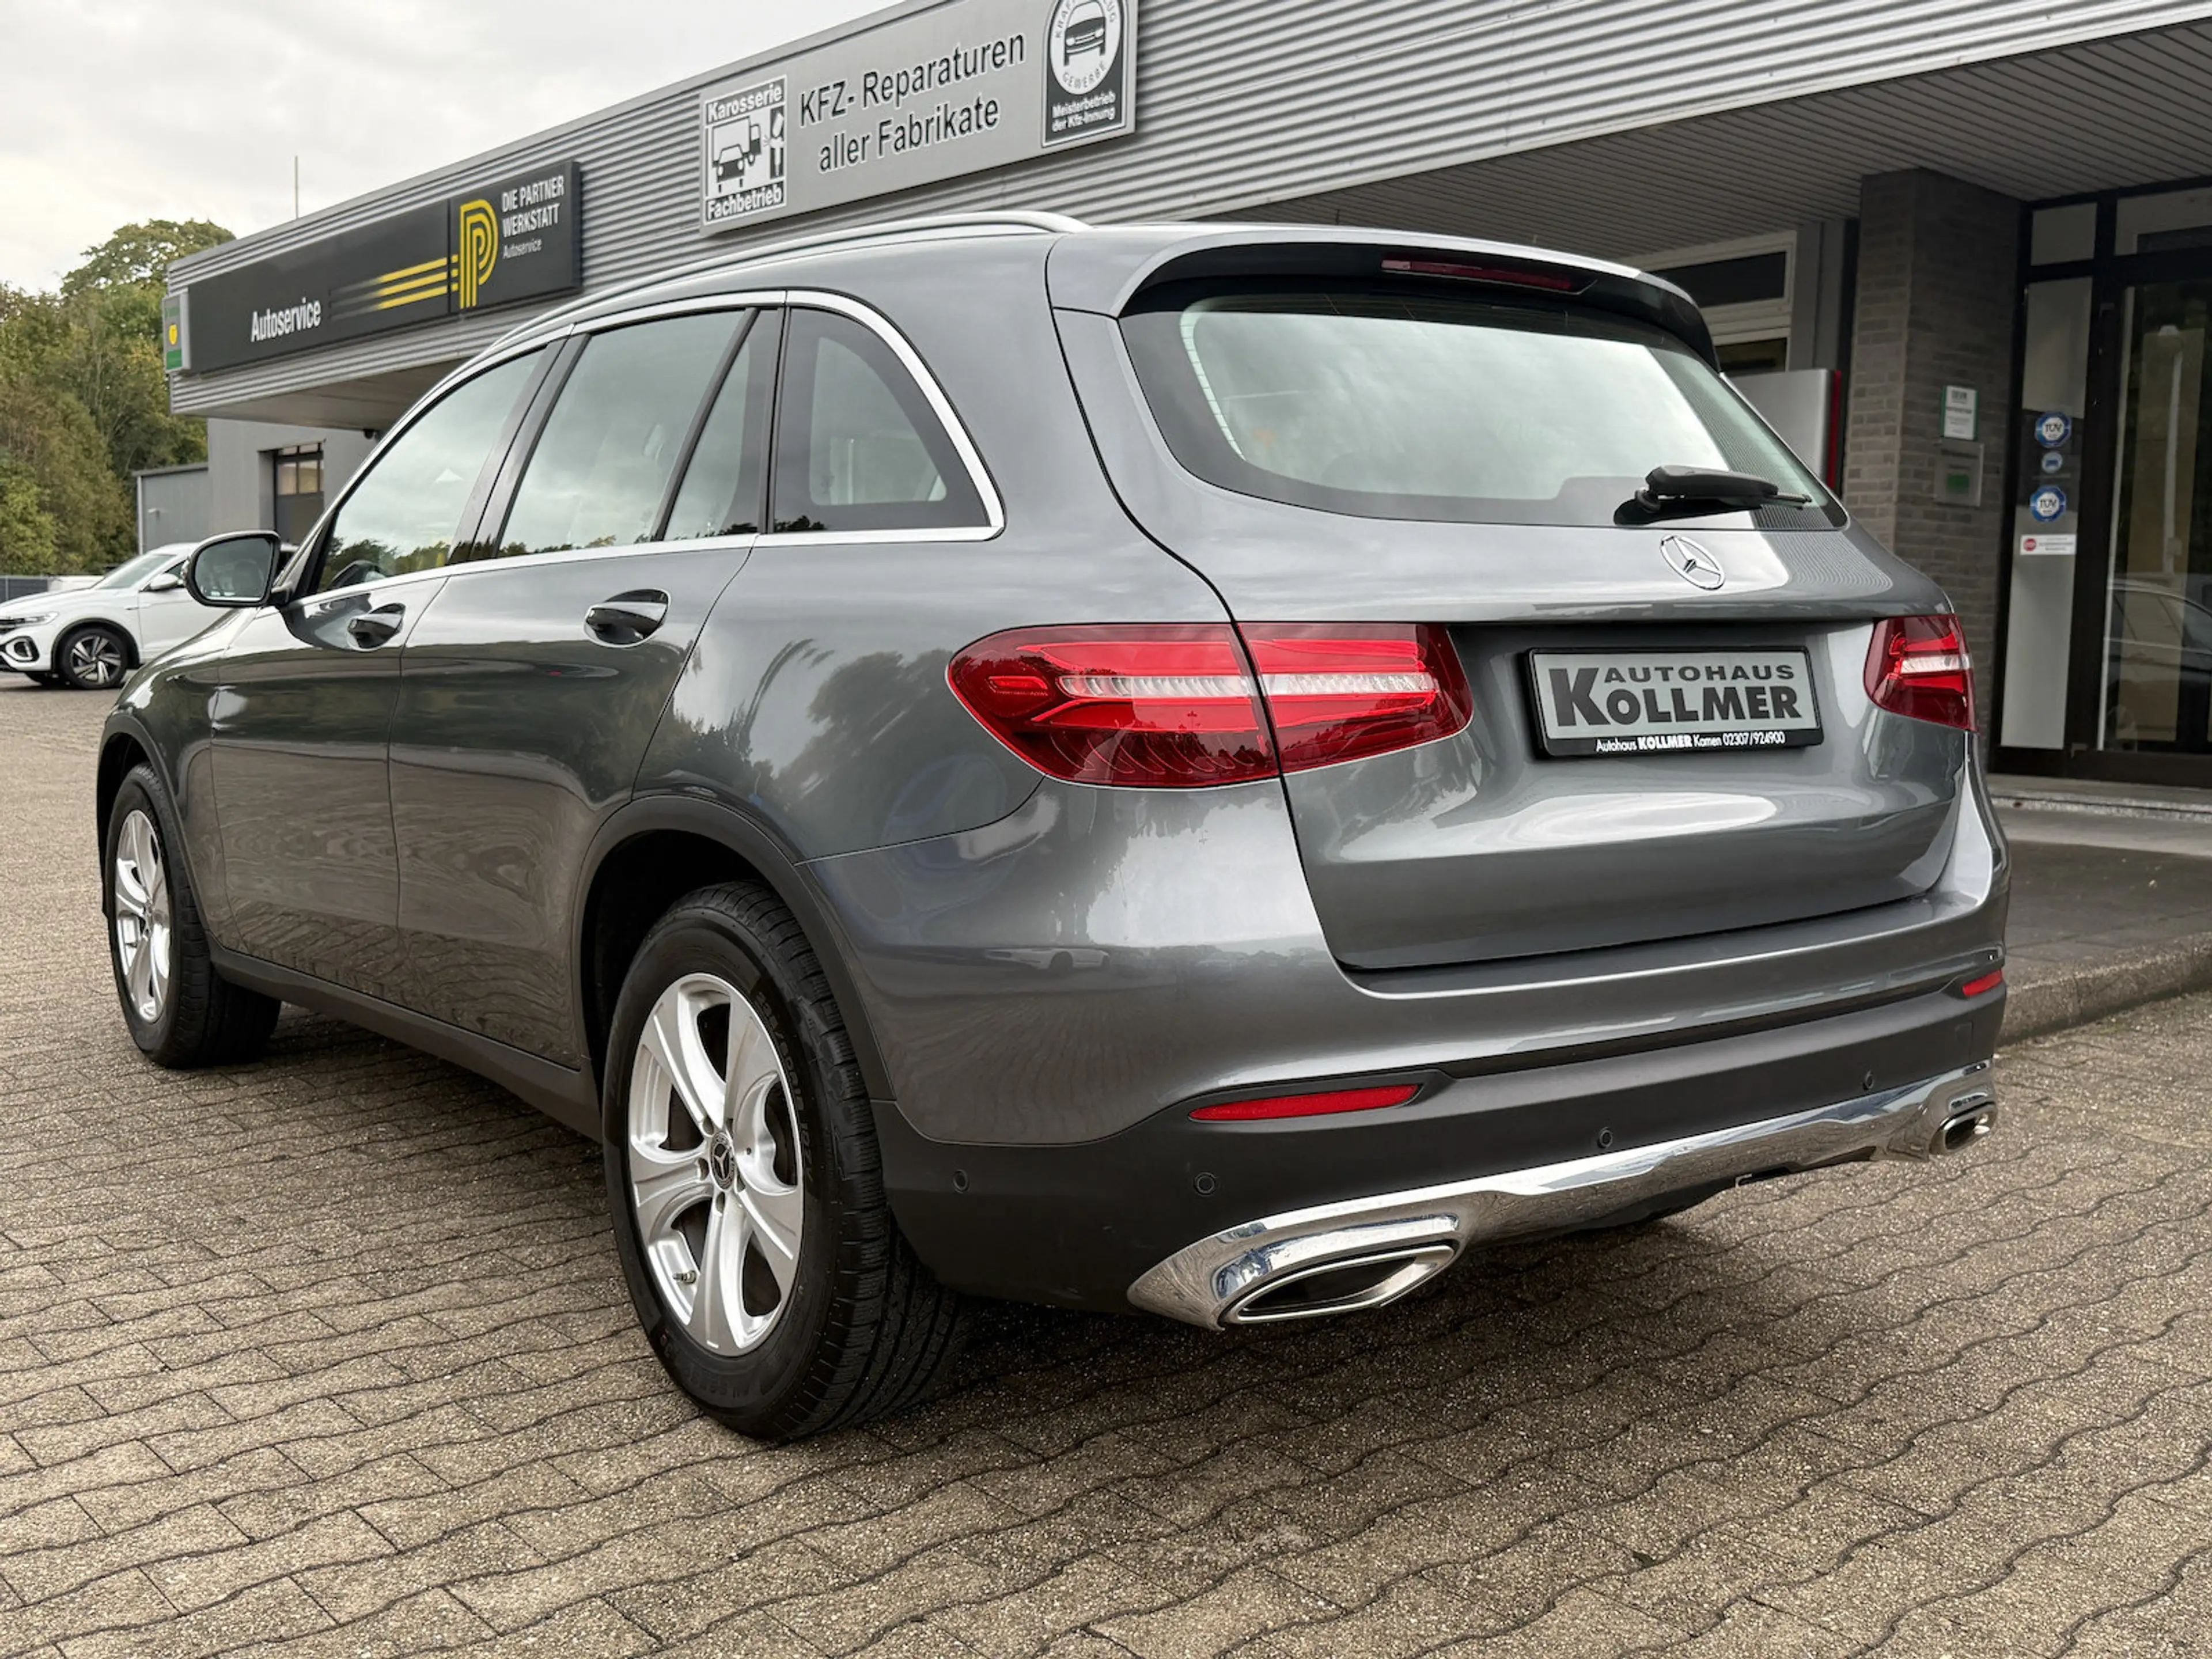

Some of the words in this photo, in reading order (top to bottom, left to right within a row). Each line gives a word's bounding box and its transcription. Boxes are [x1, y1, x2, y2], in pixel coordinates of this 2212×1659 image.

[800, 79, 855, 128] KFZ-
[863, 32, 1025, 108] Reparaturen
[707, 84, 782, 122] Karosserie
[819, 133, 869, 174] aller
[877, 96, 999, 158] Fabrikate
[502, 189, 518, 213] DIE
[520, 175, 565, 208] PARTNER
[707, 184, 782, 220] Fachbetrieb
[502, 203, 562, 238] WERKSTATT
[502, 238, 542, 259] Autoservice
[251, 297, 321, 343] Autoservice
[1604, 665, 1795, 683] AUTOHAUS
[1548, 667, 1802, 727] KOLLMER
[1596, 738, 1637, 752] Autohaus
[1638, 734, 1693, 750] KOLLMER
[1694, 734, 1722, 747] Kamen
